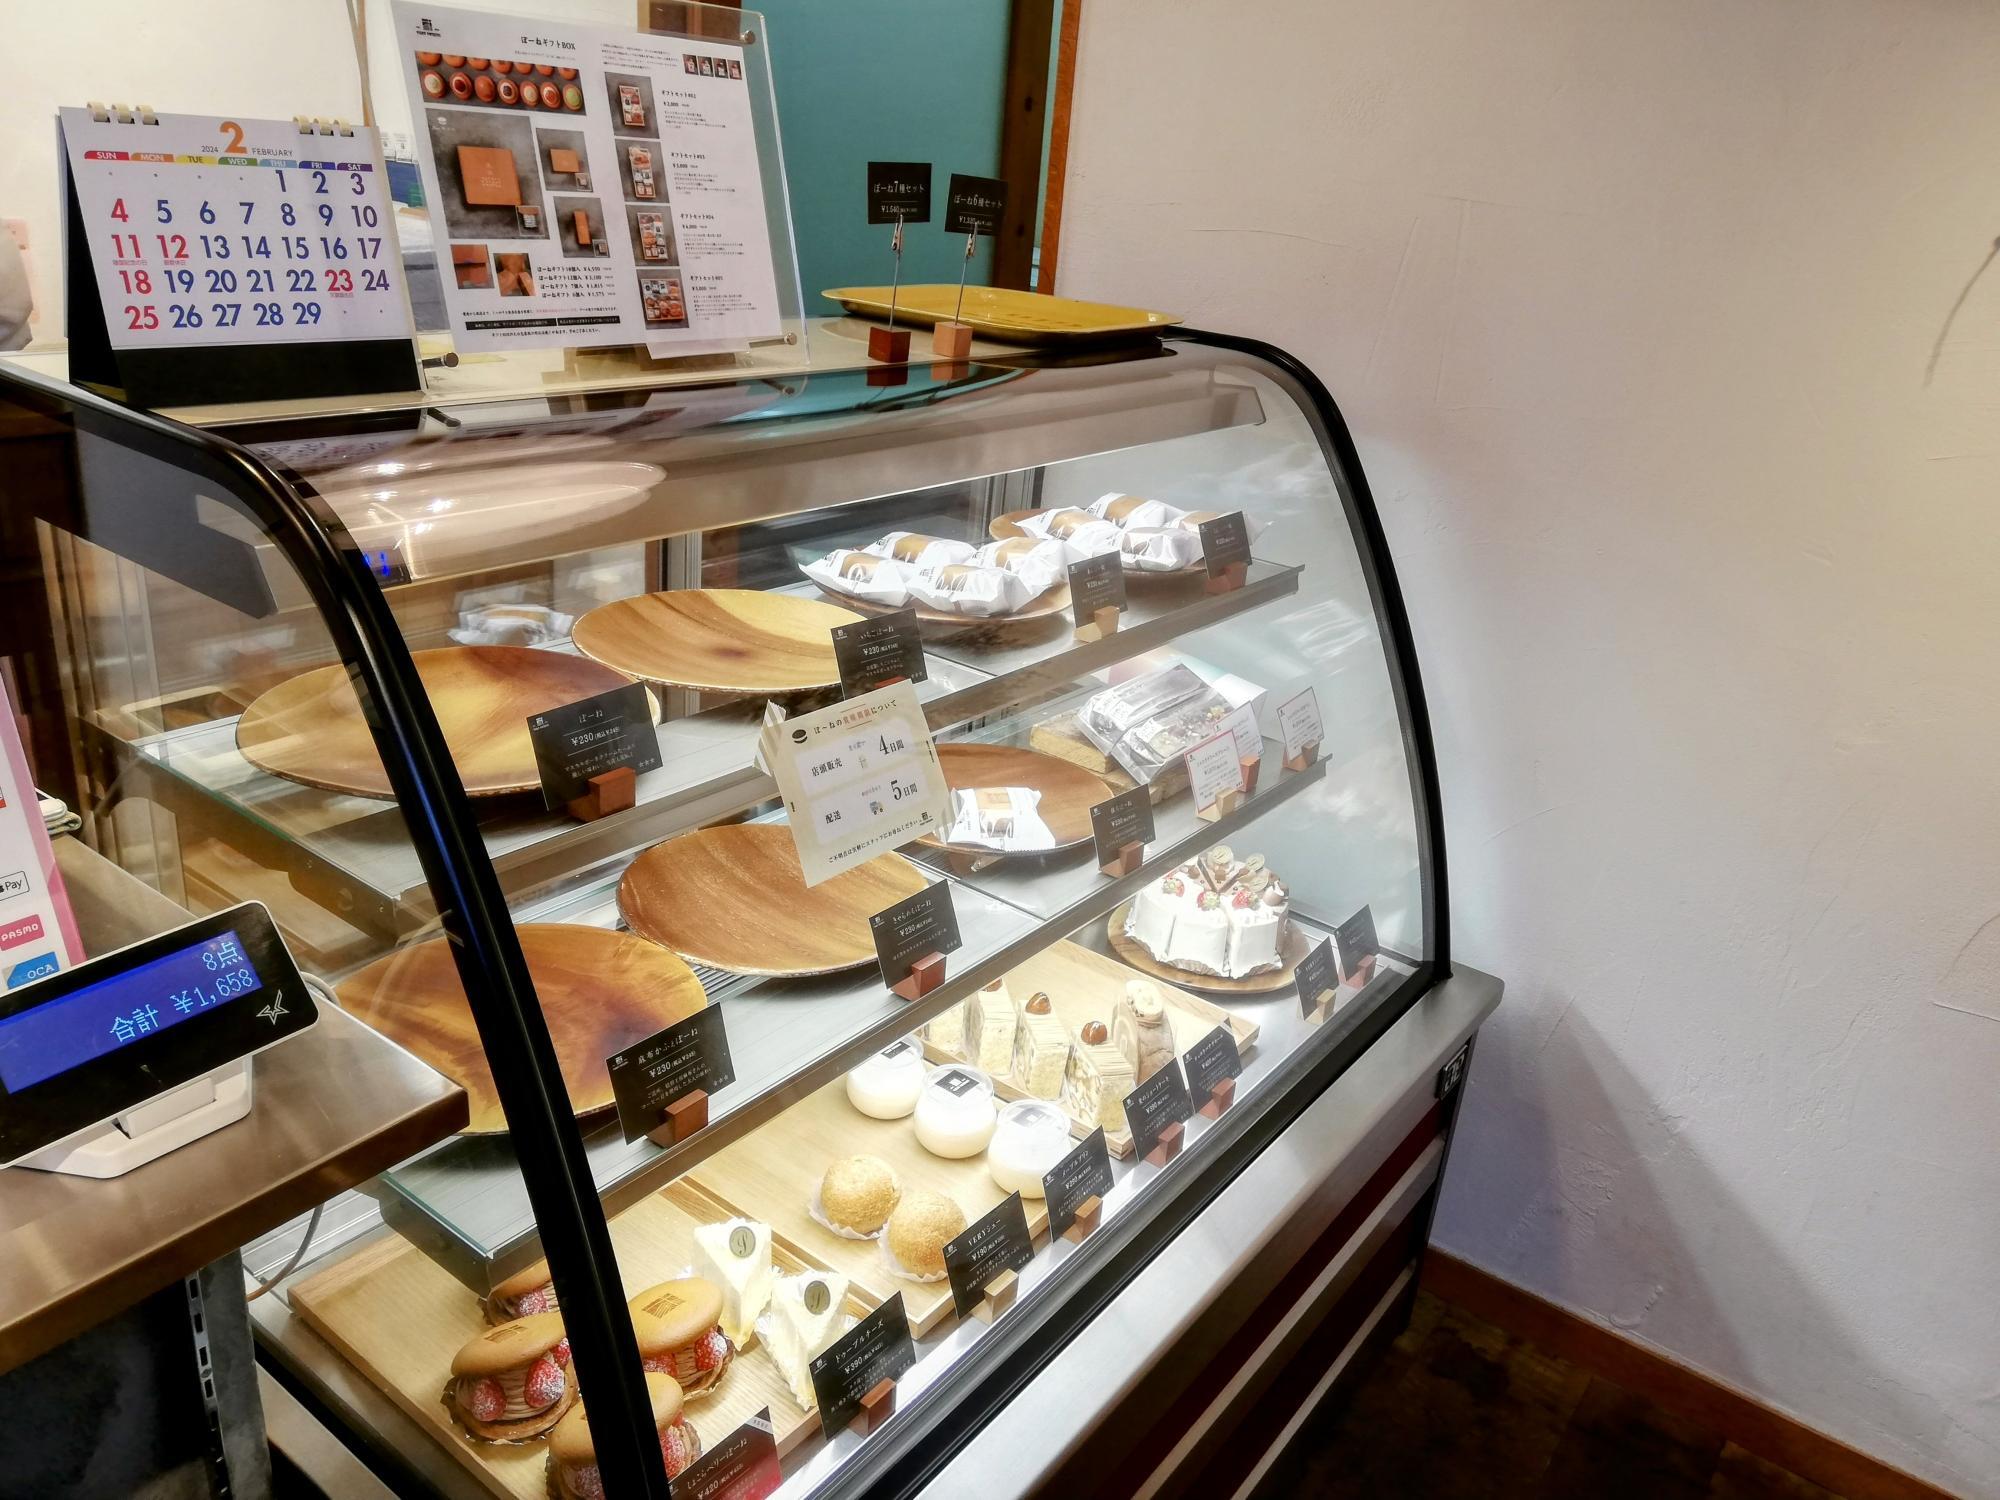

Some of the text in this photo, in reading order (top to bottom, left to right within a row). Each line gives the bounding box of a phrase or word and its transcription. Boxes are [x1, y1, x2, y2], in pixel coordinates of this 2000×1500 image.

[202, 121, 293, 157] 2024 2 FEBRUARY
[96, 152, 362, 172] SUN MON TUE WED THU FRI SAT
[275, 170, 365, 196] 1 2 3
[873, 180, 926, 194] ぼーね7種セット
[111, 198, 378, 228] 4 5 6 7 8 9 10
[111, 234, 382, 260] 11 12 13 14 15 16 17
[119, 269, 390, 294] 18 19 20 21 22 23 24
[124, 302, 322, 330] 25 26 27 28 29
[862, 646, 880, 656] ¥230
[579, 709, 604, 724] ぼーね
[571, 732, 594, 746] ¥230
[879, 734, 905, 755] 4日間
[811, 758, 843, 778] 店頭販売
[890, 779, 918, 801] 5日間
[825, 810, 842, 824] 配送
[4, 880, 22, 891] Pay
[2, 923, 39, 942] PASMO
[202, 941, 244, 971] 8点
[109, 968, 253, 1042] 合計 ¥1,658
[649, 1061, 672, 1078] ¥230
[968, 1219, 1001, 1246] VERYシュー
[971, 1246, 988, 1262] ¥190
[844, 1356, 863, 1374] ¥390
[696, 1480, 720, 1500] ¥420
